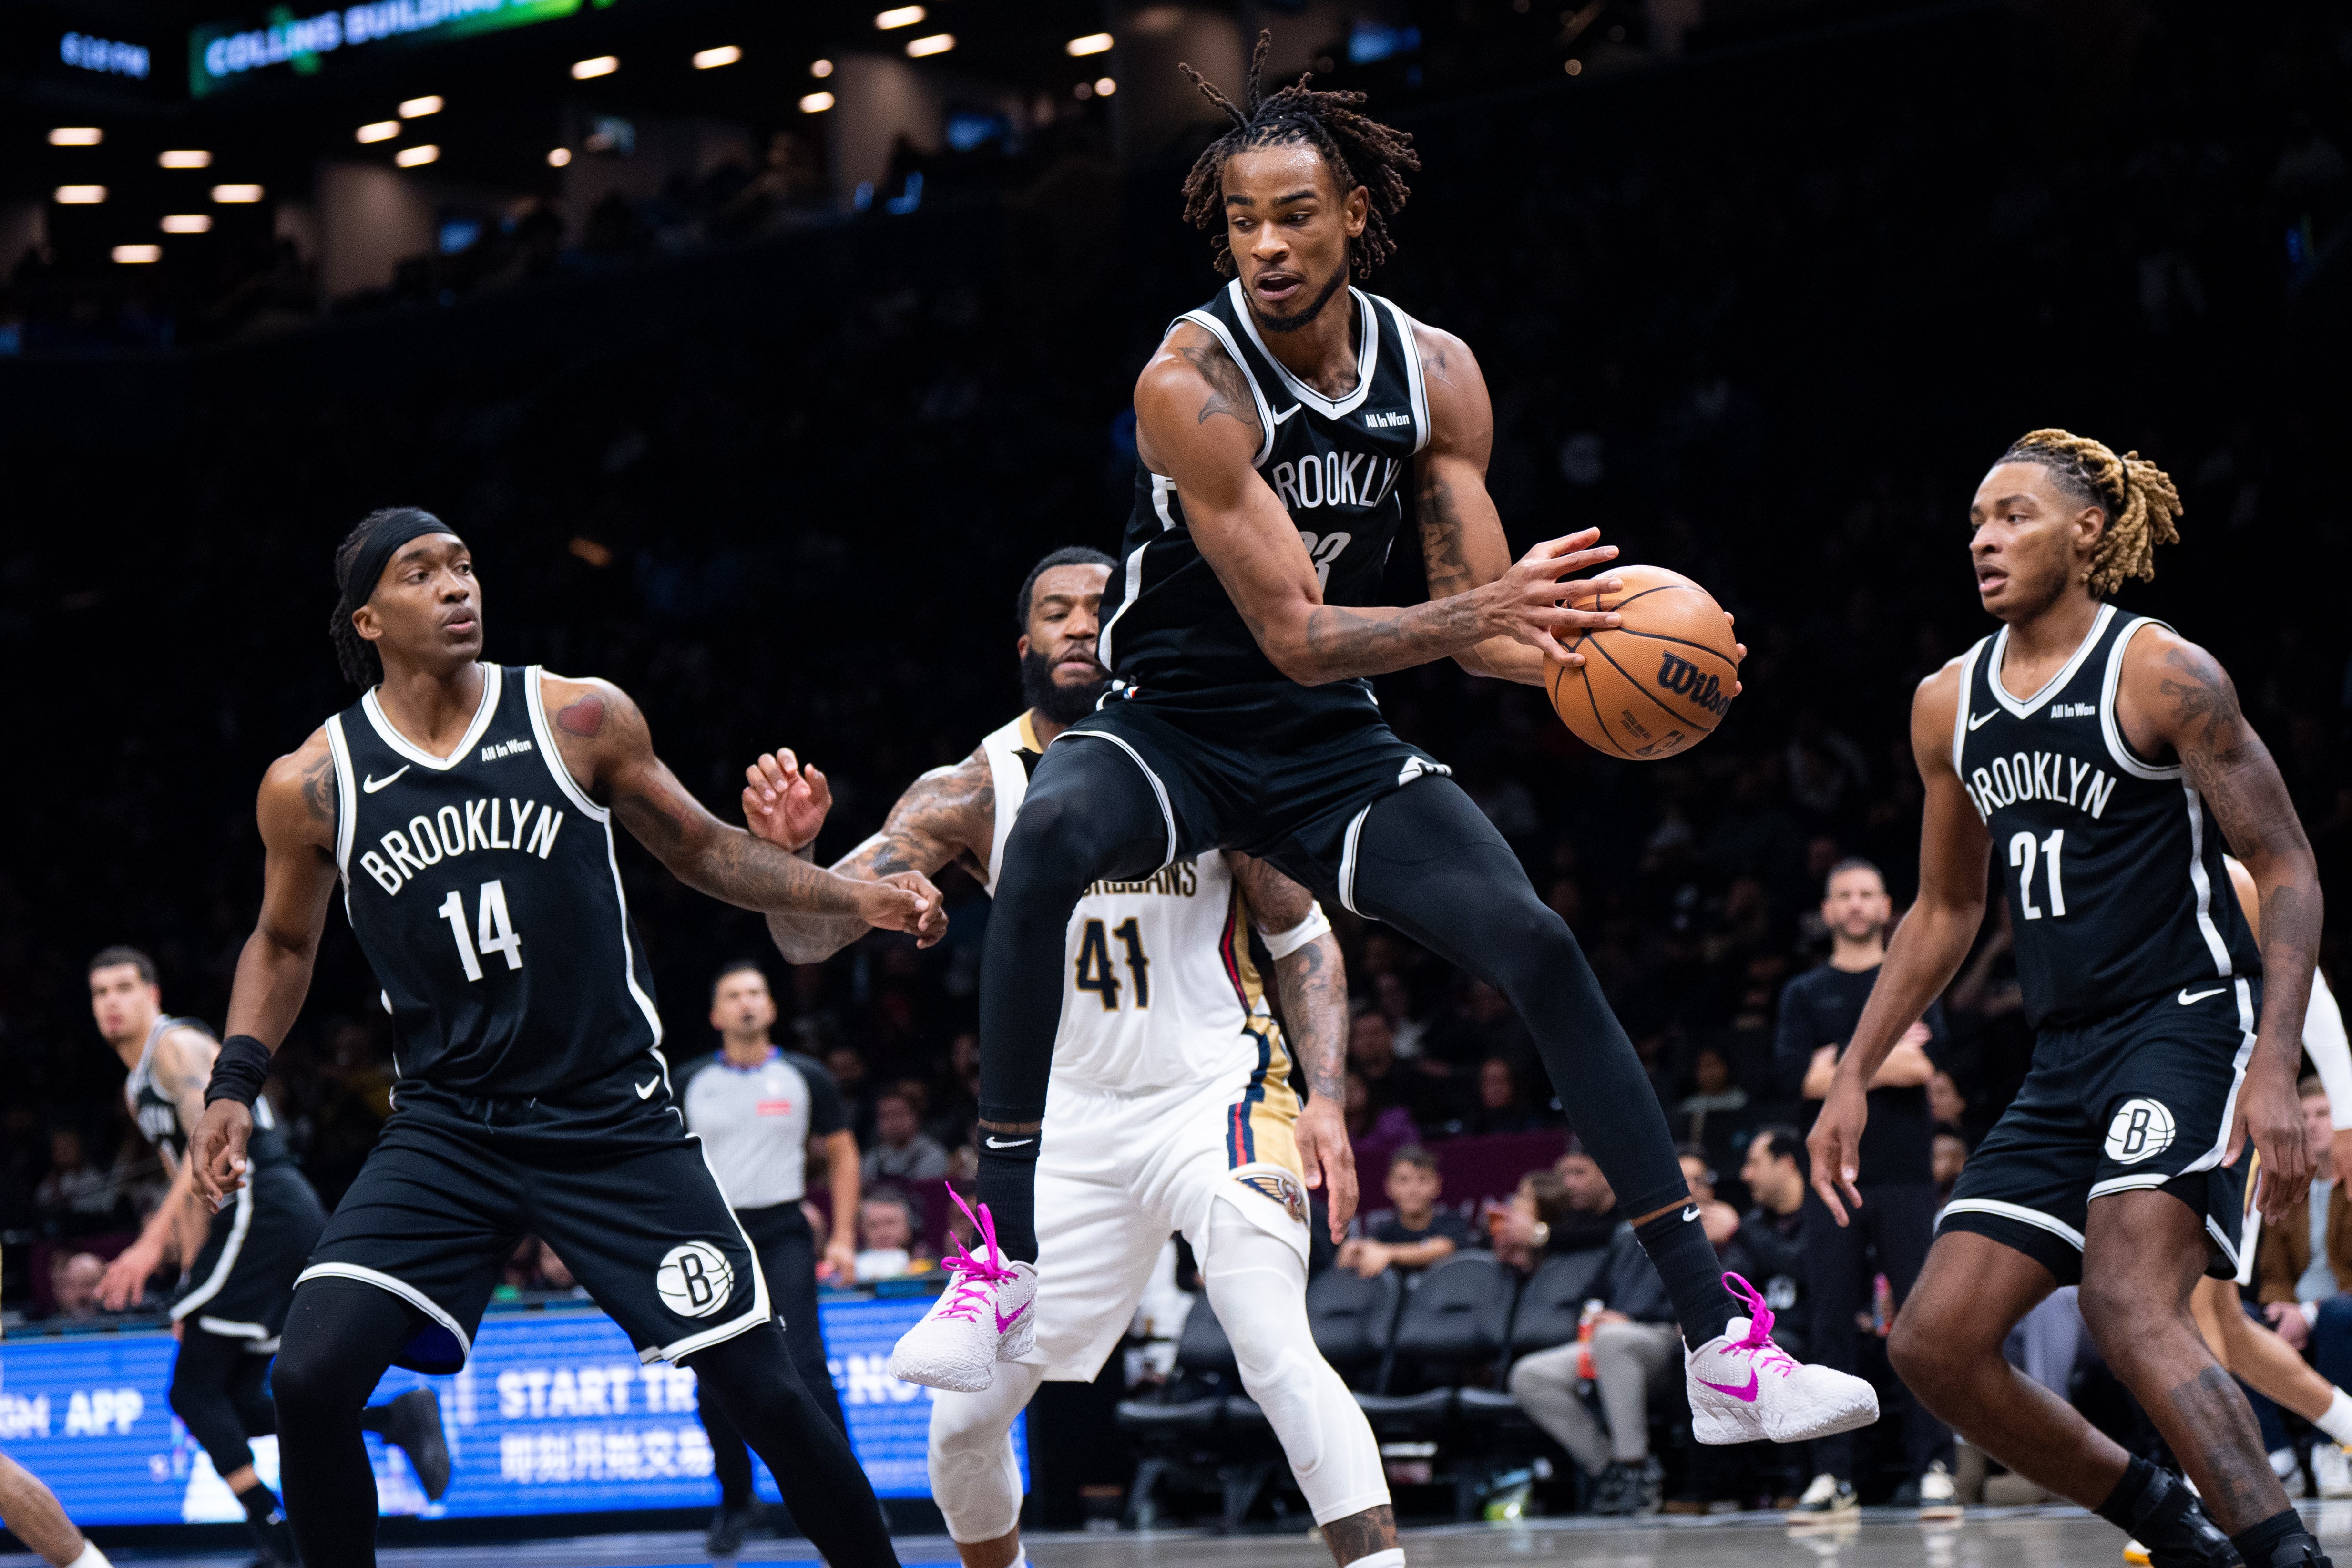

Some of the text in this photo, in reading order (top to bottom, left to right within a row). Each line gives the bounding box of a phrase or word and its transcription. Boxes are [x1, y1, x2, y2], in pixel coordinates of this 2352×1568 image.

[204, 10, 342, 77] COLLINS
[1365, 412, 1410, 428] All In Won
[1272, 451, 1402, 511] ROOKLY
[1657, 650, 1731, 716] Wilso
[2051, 702, 2096, 719] All In Won
[481, 738, 532, 762] All In Won
[360, 798, 563, 896] BROOKLYN
[2009, 829, 2066, 920] 21
[438, 880, 523, 982] 14
[1074, 916, 1150, 1012] 41
[2122, 1108, 2151, 1154] B
[678, 1253, 713, 1308] B
[64, 1388, 144, 1437] APP
[497, 1366, 636, 1419] START
